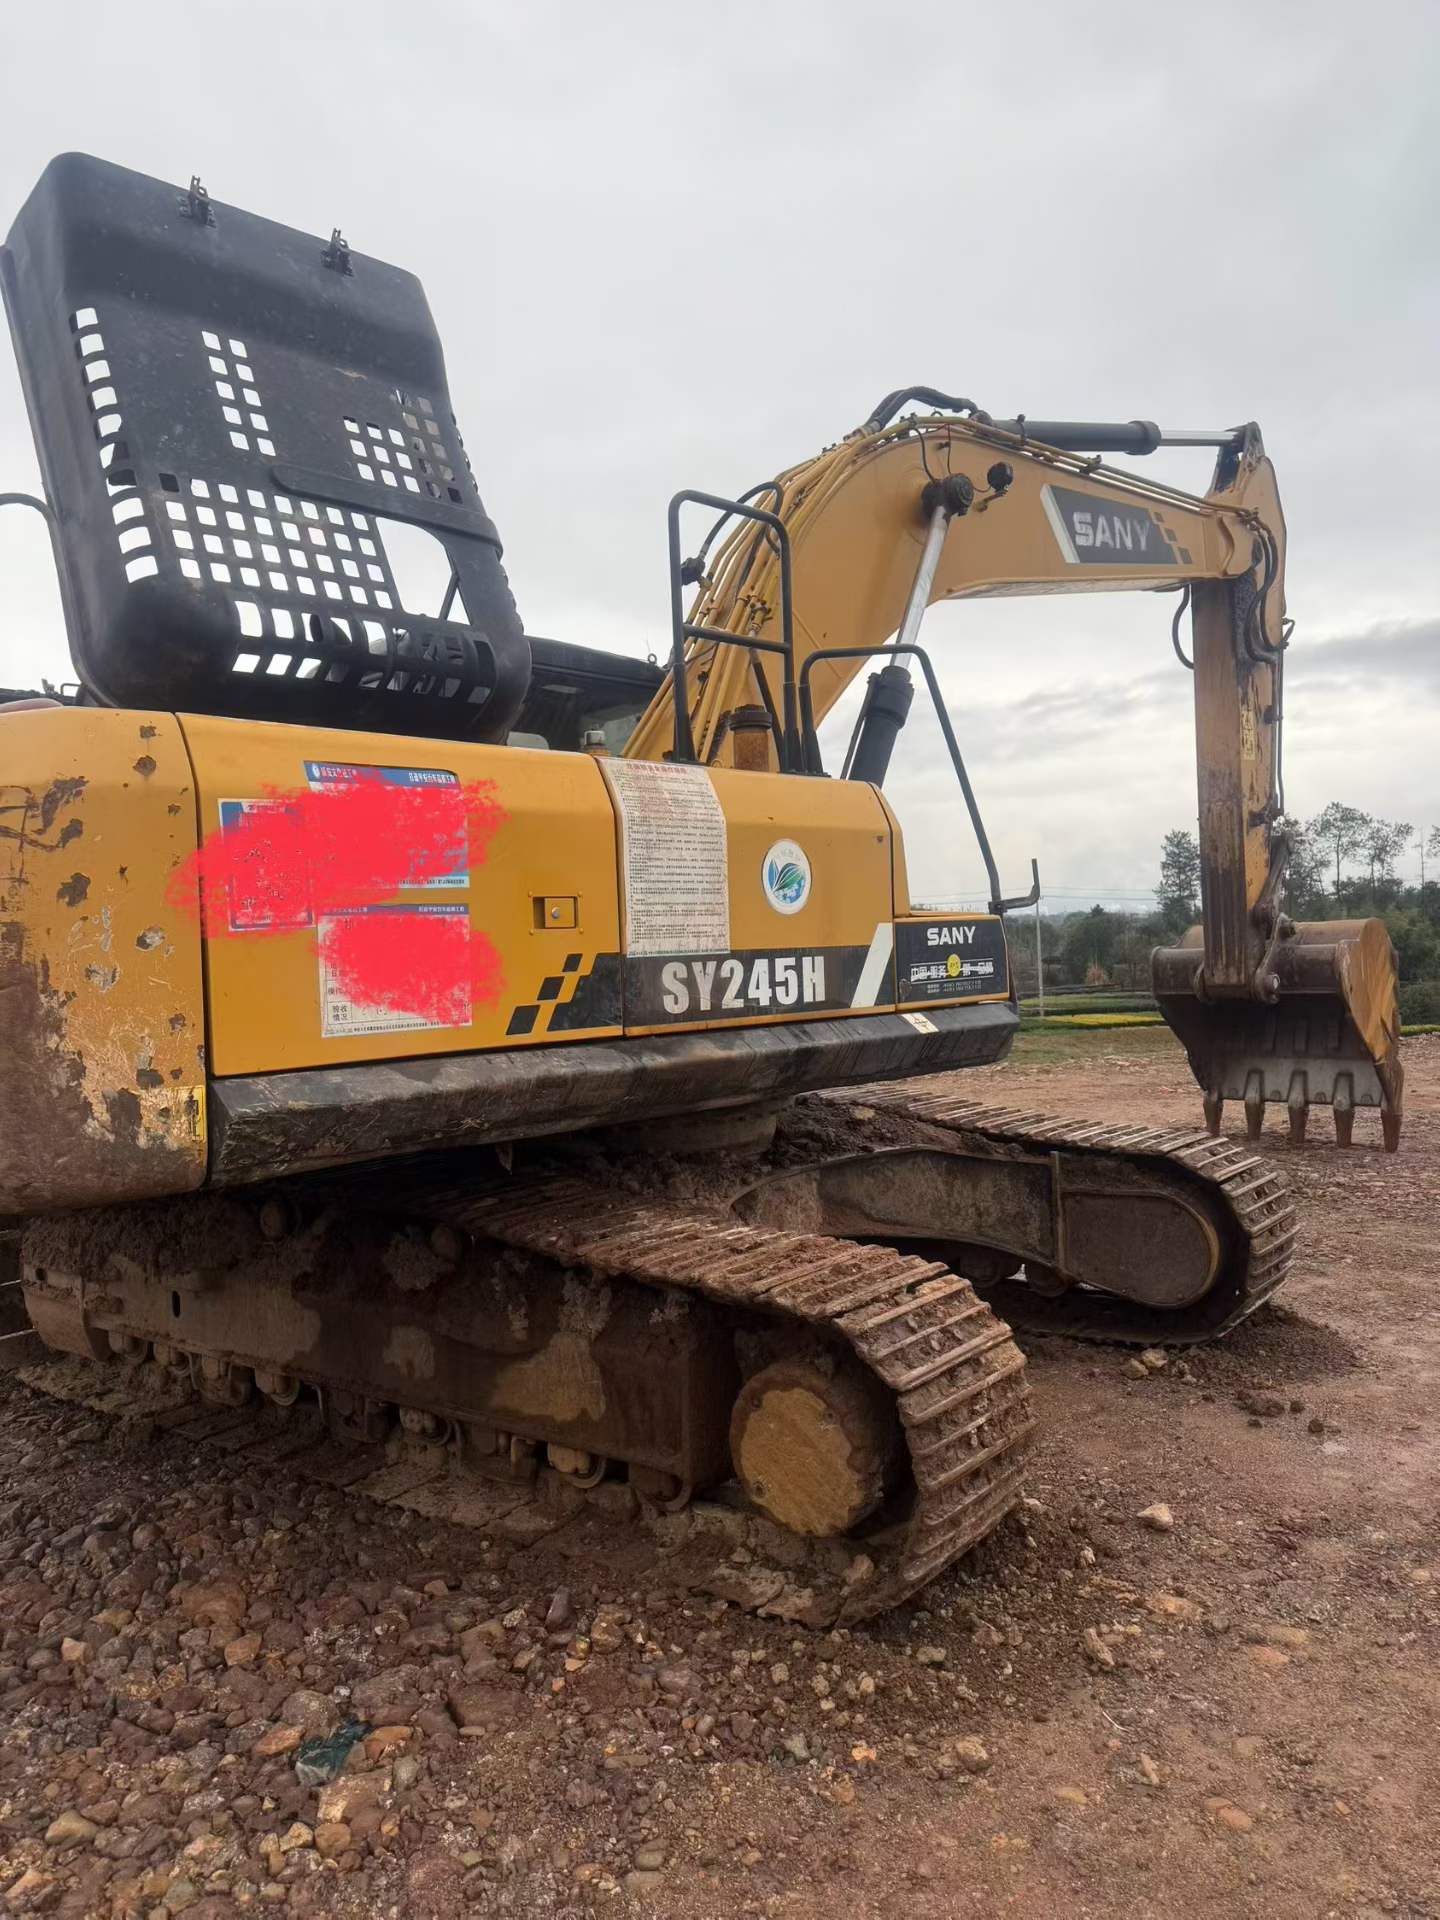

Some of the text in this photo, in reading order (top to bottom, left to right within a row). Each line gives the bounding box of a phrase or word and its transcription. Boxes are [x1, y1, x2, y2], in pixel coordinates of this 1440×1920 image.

[1073, 511, 1150, 551] SANY
[927, 926, 976, 946] SANY
[661, 956, 826, 1014] SY245H
